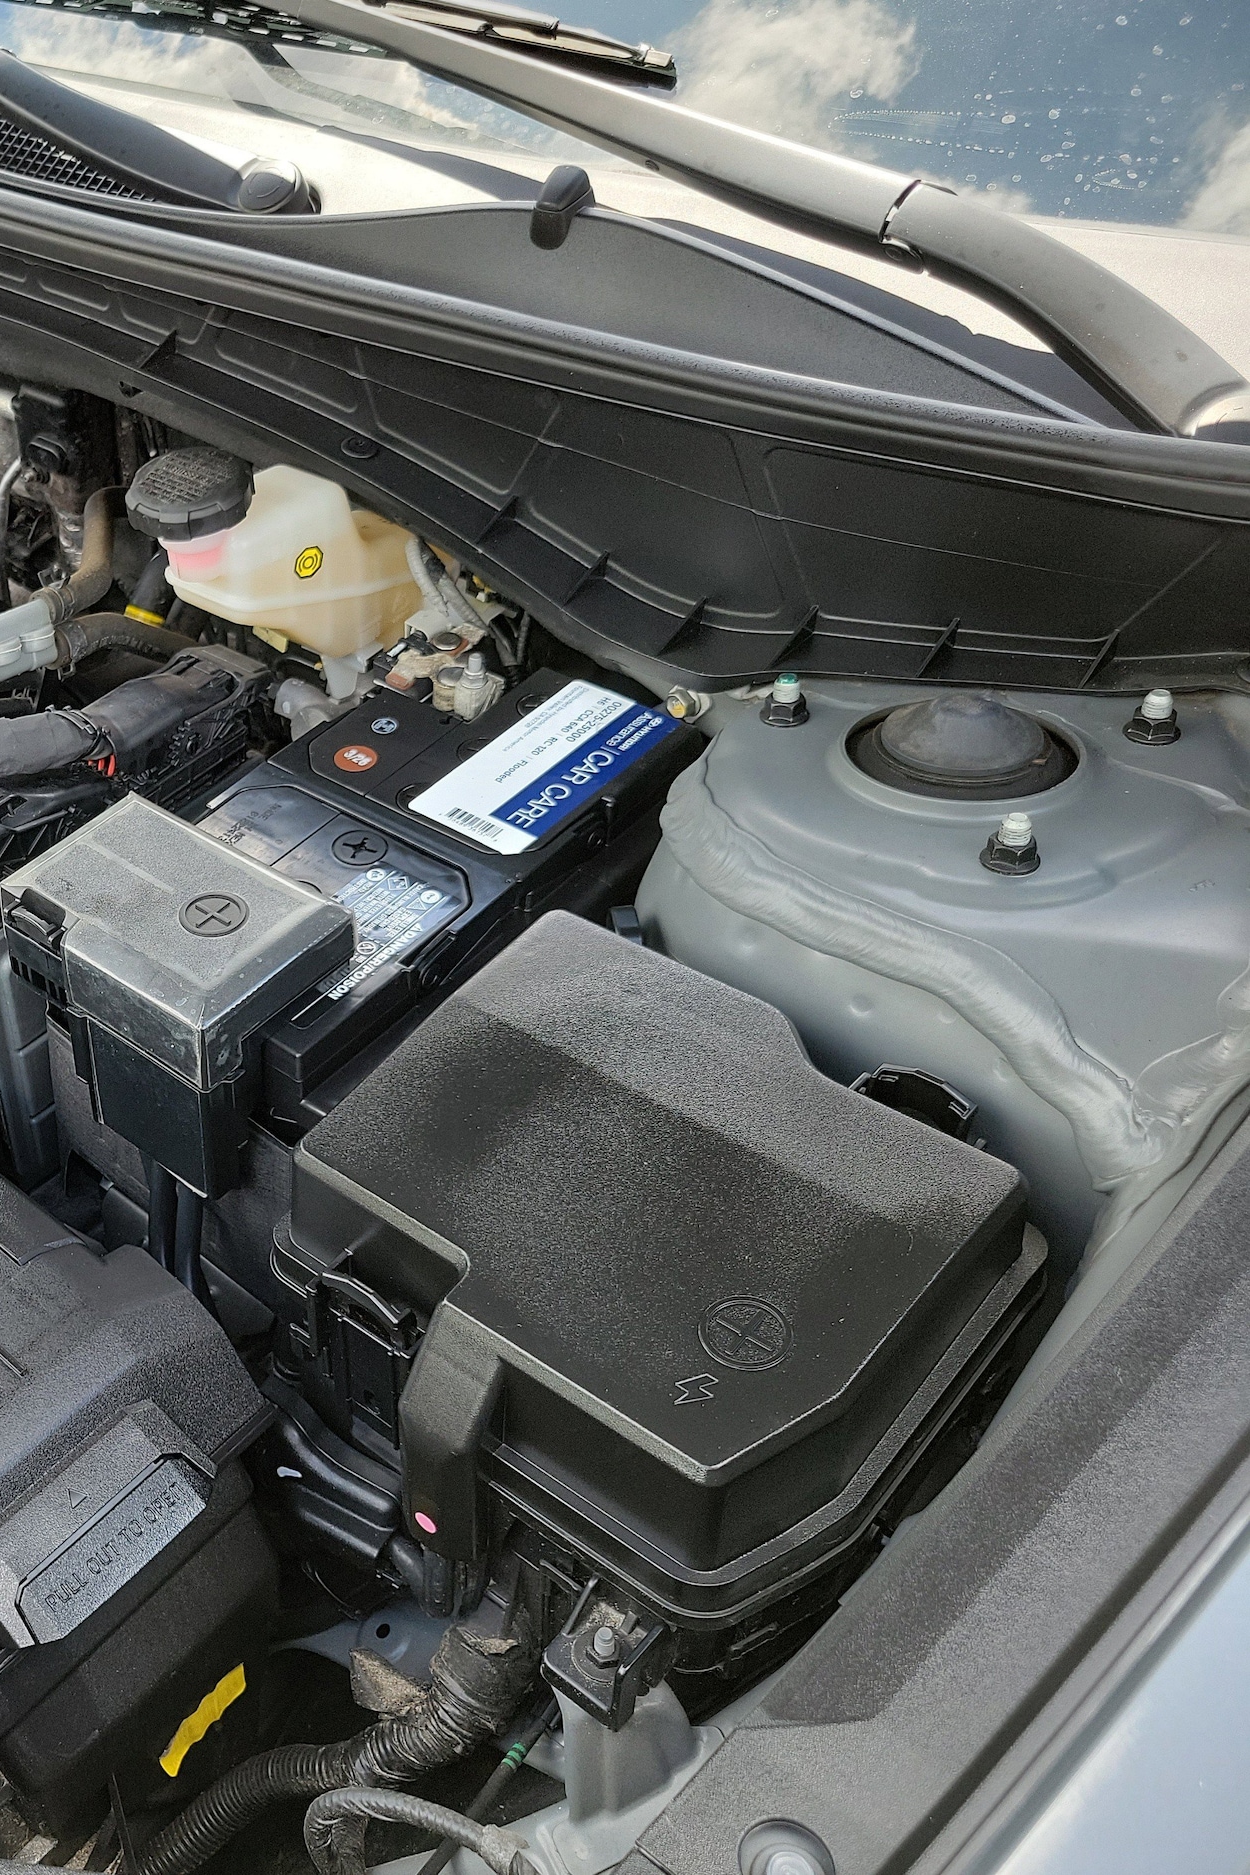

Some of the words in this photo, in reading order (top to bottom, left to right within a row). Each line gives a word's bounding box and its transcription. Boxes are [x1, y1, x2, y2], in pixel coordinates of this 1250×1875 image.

[559, 720, 577, 733] 640
[564, 700, 622, 744] 00275-25000
[574, 708, 593, 722] CCA
[604, 711, 652, 748] Assurance
[530, 744, 545, 756] 120
[542, 735, 558, 747] RC
[616, 725, 652, 751] HYUNDAI
[493, 758, 527, 784] Flooded
[561, 751, 615, 786] CAR
[506, 783, 570, 830] CARE
[327, 930, 417, 1001] DANGER/POISON
[44, 1572, 89, 1612] PULL
[86, 1541, 121, 1575] OUT
[118, 1519, 144, 1545] TO
[143, 1481, 187, 1524] OPEN
